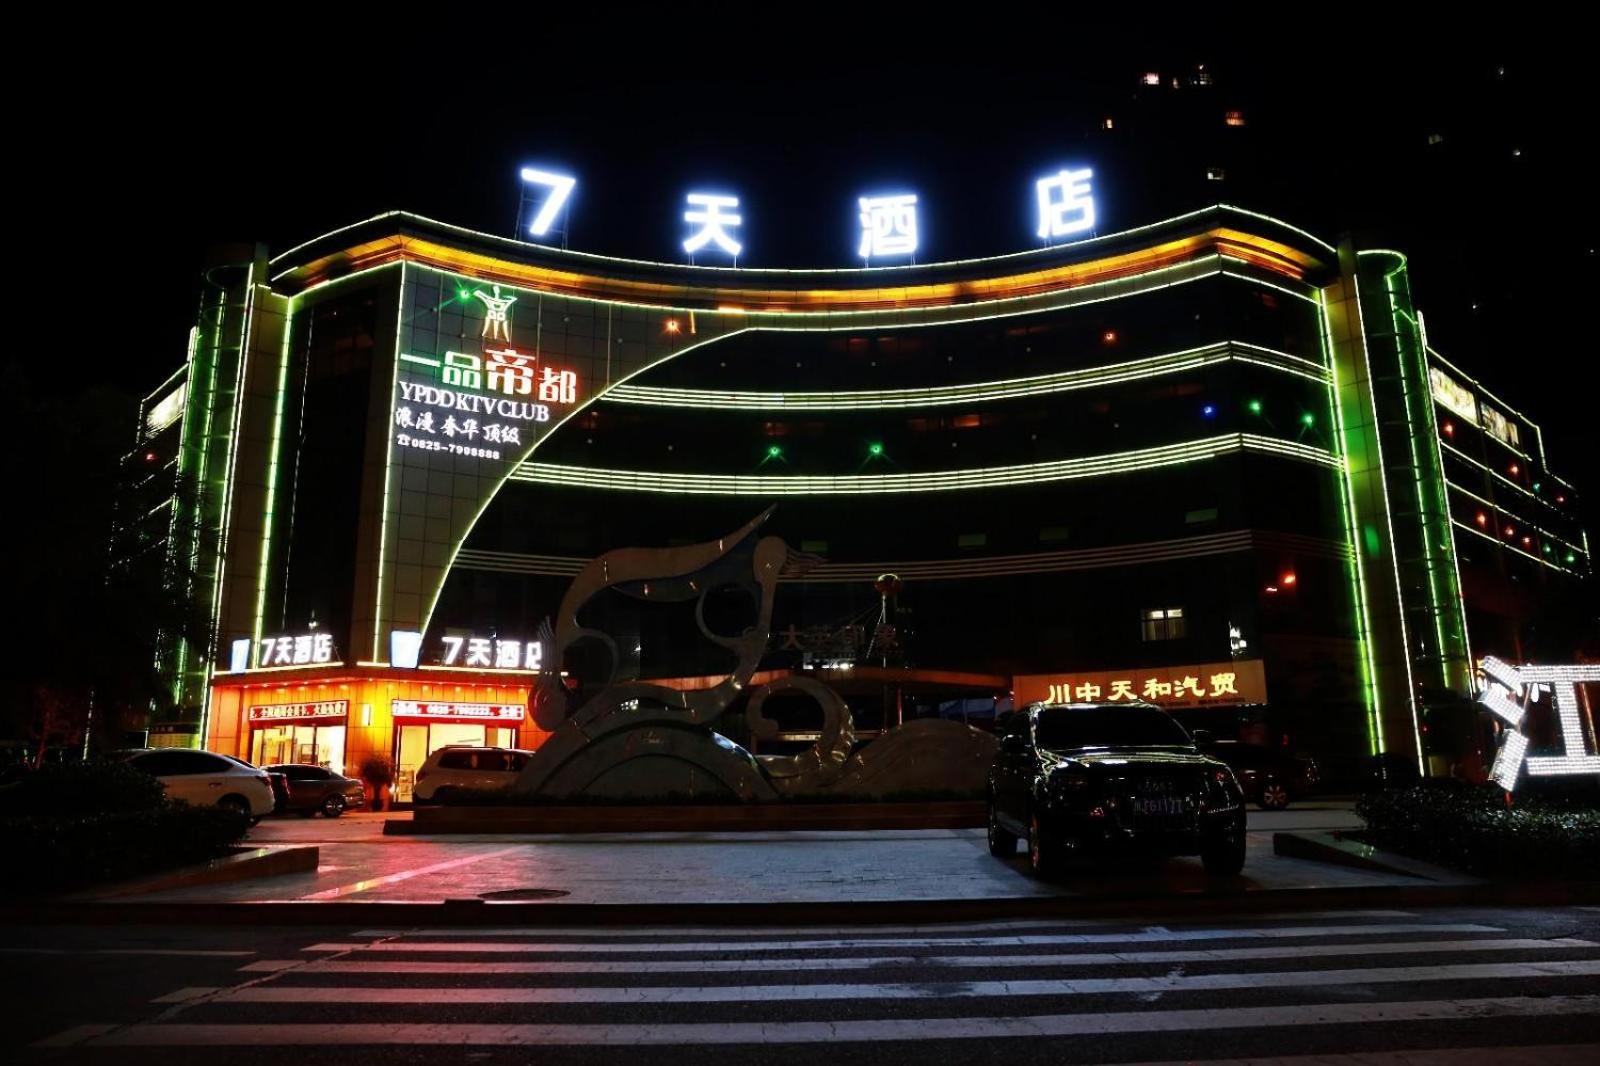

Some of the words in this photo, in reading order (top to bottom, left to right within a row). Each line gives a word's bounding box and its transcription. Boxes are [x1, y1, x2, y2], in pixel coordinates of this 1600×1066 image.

[519, 167, 1098, 256] 7天酒店
[400, 348, 577, 404] 一品帝都
[261, 633, 333, 666] 7天酒店
[1045, 672, 1239, 704] 川中天和汽贸
